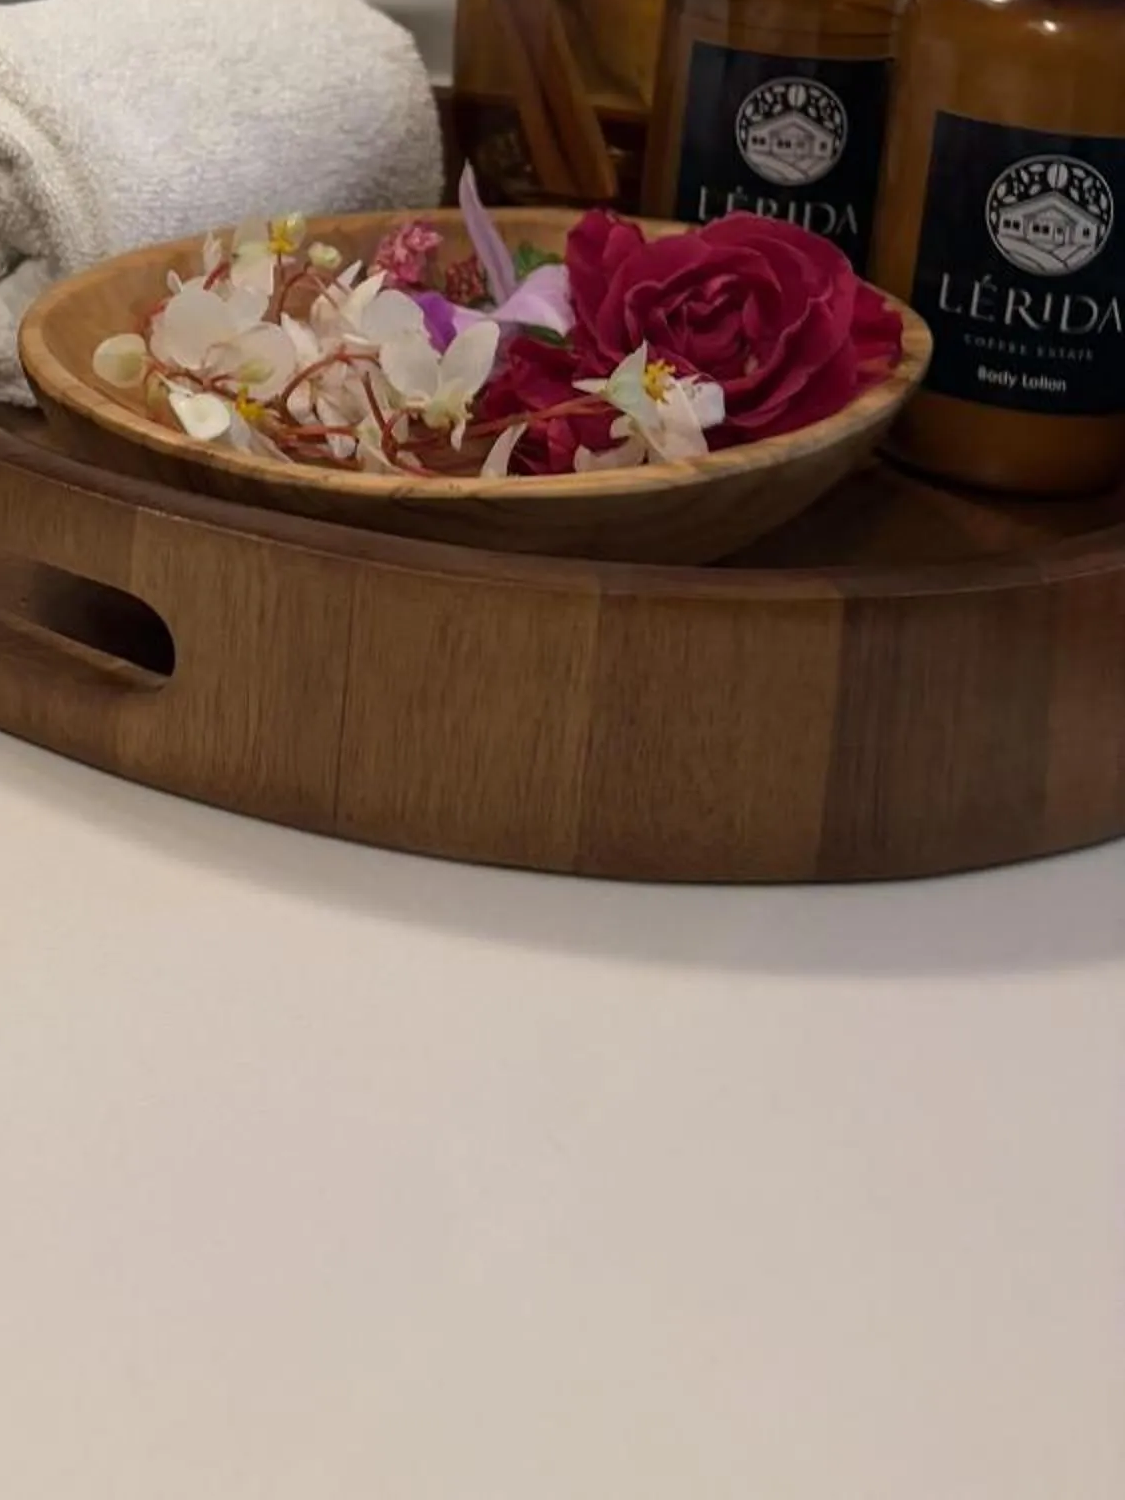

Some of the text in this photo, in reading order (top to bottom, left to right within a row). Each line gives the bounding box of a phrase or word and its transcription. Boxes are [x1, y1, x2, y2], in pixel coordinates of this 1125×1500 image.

[939, 272, 1122, 334] LÉRIDA
[977, 366, 1067, 392] Body Lotion
